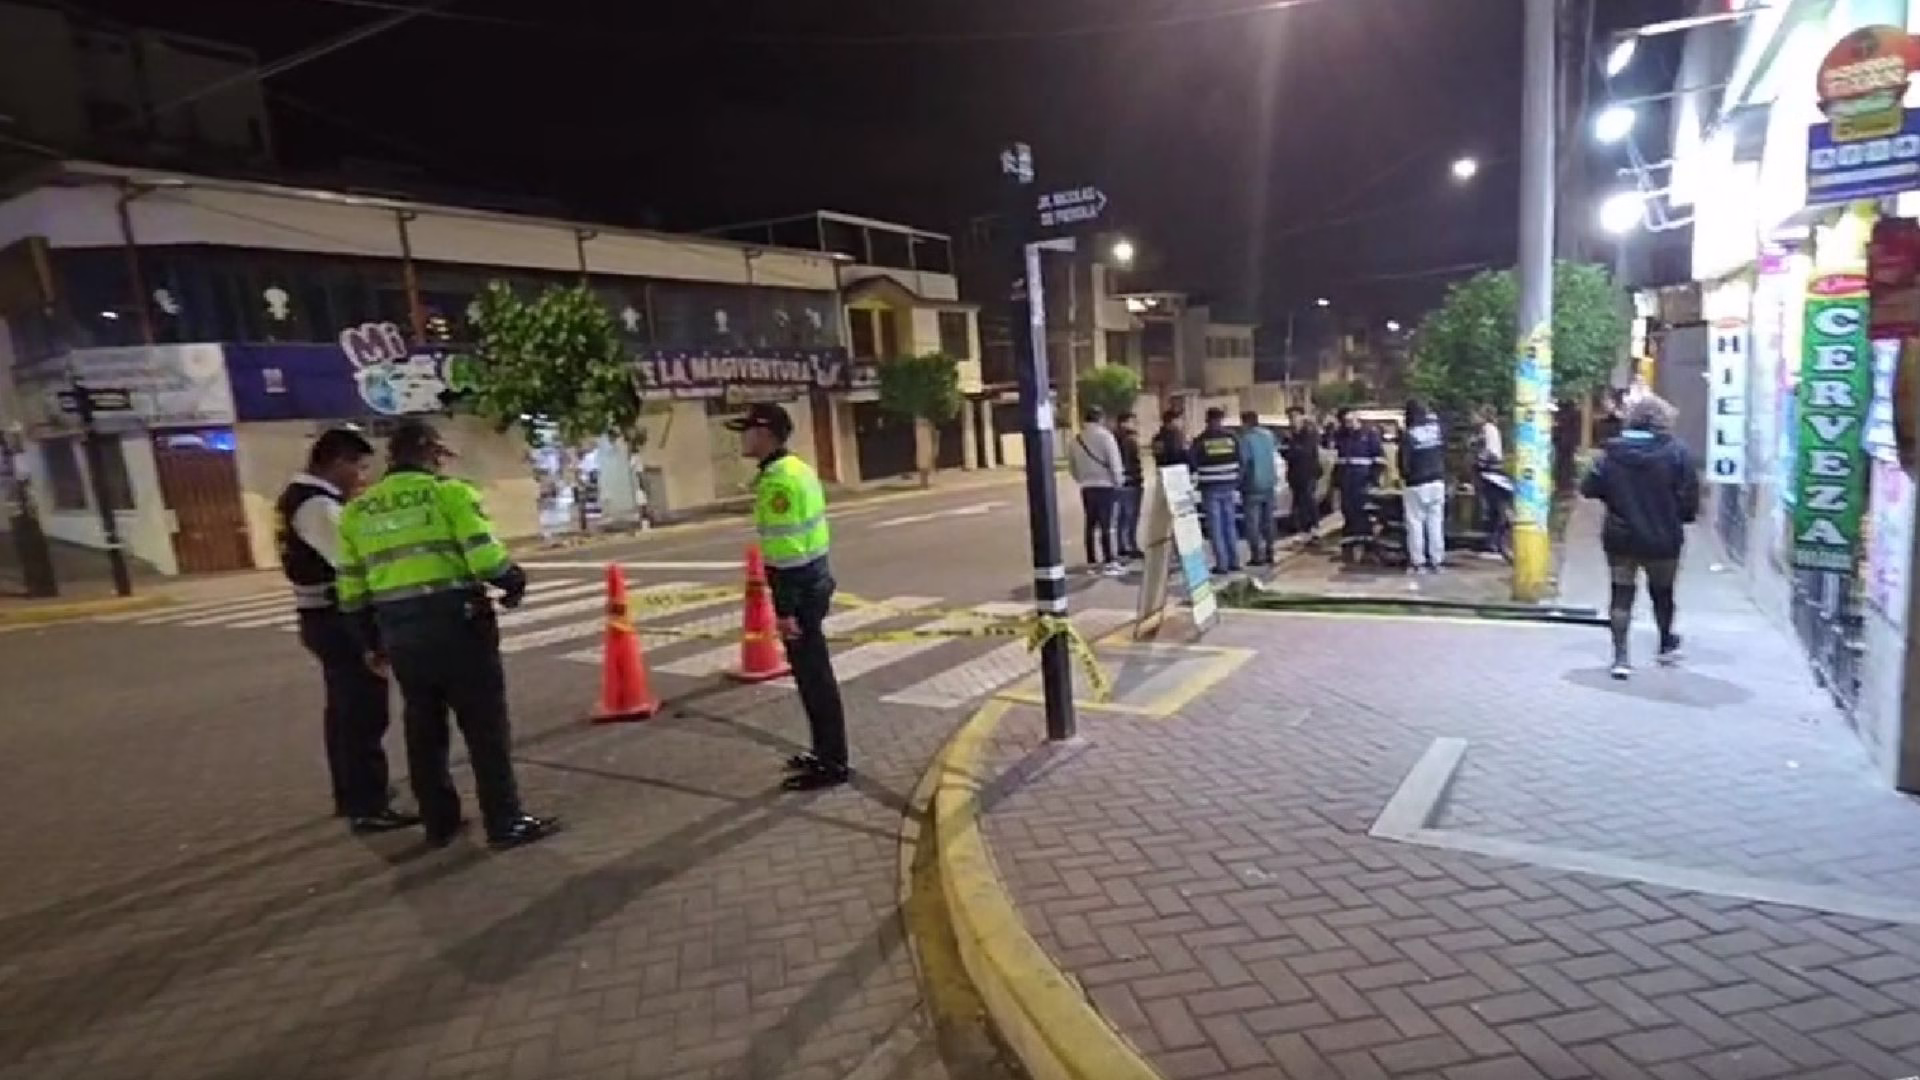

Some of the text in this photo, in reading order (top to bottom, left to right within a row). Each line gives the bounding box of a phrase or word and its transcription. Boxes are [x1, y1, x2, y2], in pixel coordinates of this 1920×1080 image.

[1715, 335, 1744, 476] HIELO
[1796, 307, 1864, 546] CERVEZA
[357, 487, 435, 516] POLICIA
